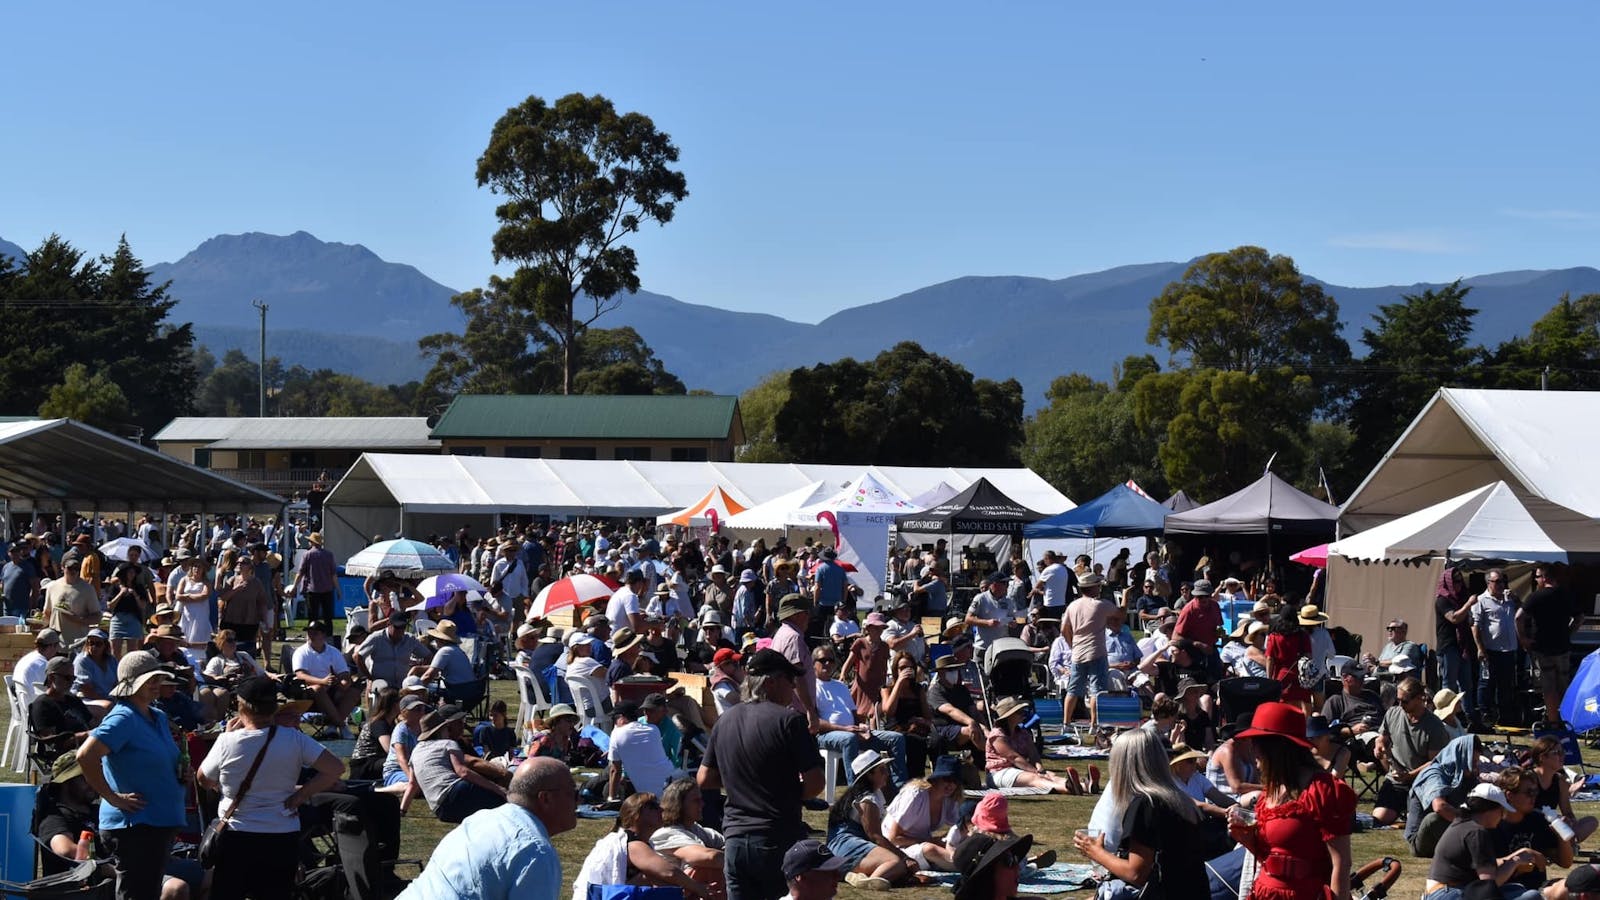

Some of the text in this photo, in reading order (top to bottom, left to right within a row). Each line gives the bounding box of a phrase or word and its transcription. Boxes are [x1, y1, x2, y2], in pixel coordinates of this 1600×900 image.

[866, 515, 884, 523] FACE
[956, 521, 995, 531] SMOKED
[996, 522, 1018, 531] SALT
